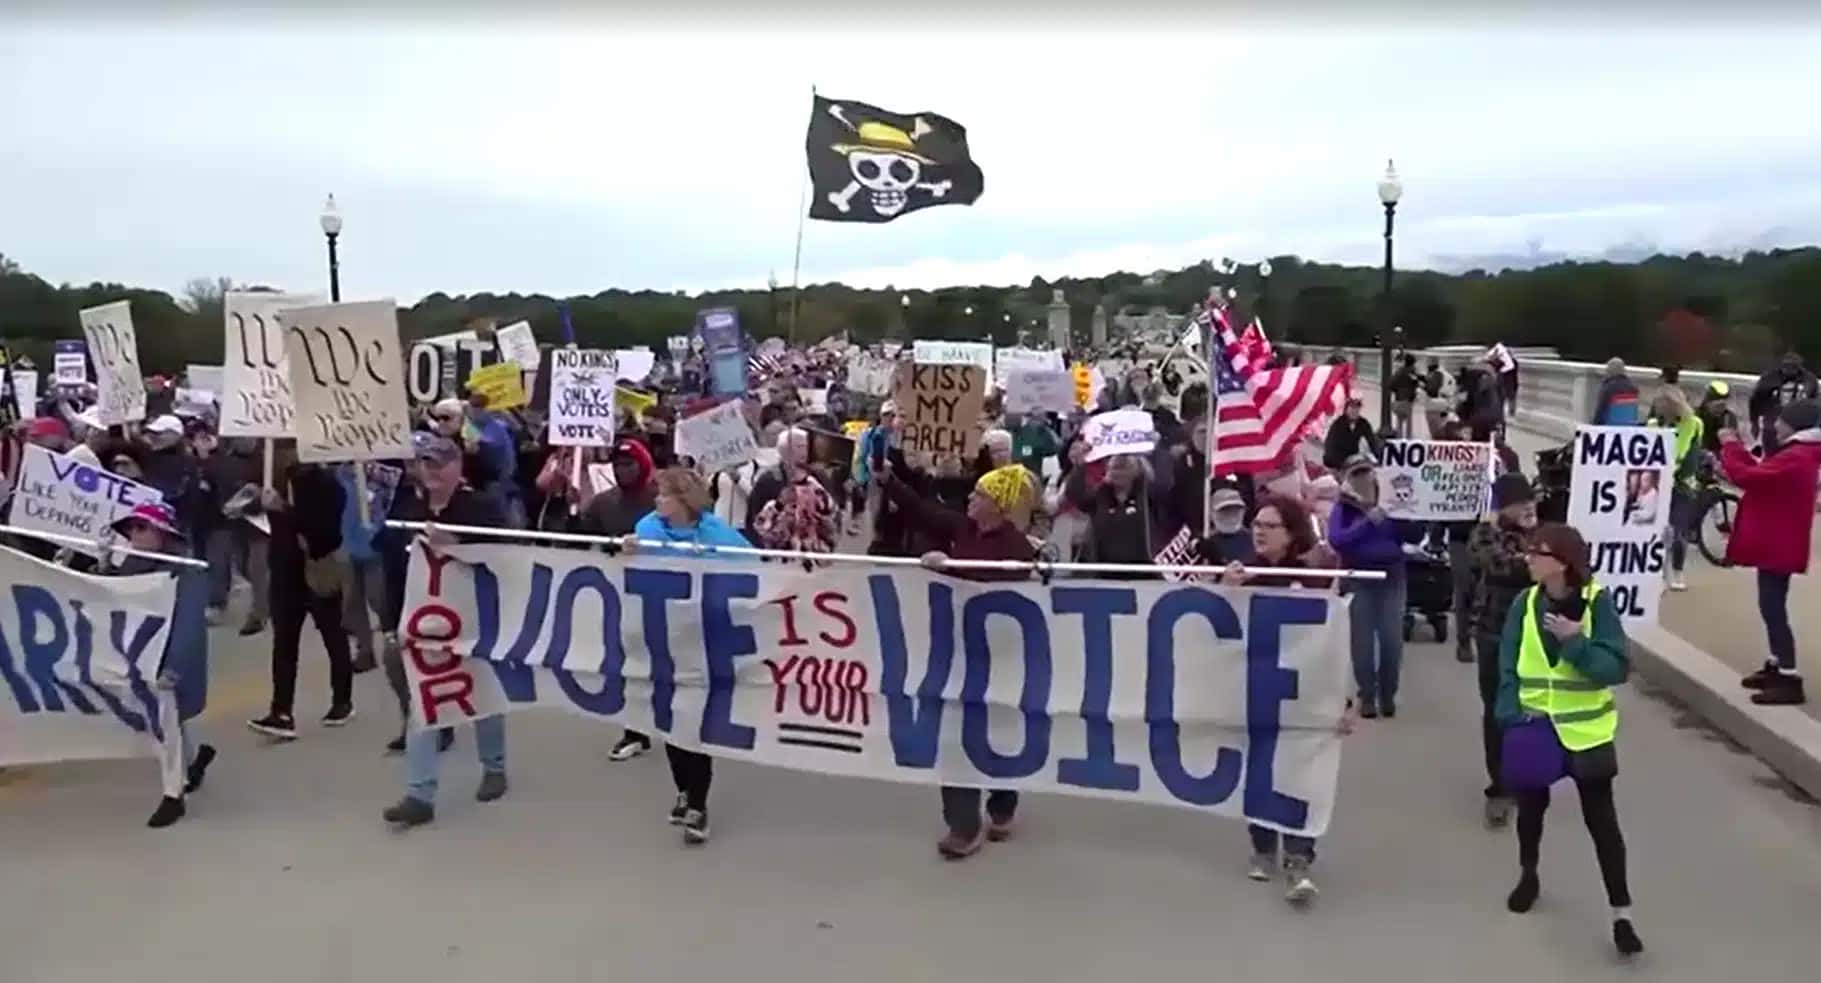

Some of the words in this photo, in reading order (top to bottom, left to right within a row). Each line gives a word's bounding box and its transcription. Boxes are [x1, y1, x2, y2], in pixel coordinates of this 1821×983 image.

[231, 311, 282, 368] W
[291, 325, 387, 387] We
[557, 351, 577, 368] NO
[911, 364, 972, 392] KISS
[233, 391, 293, 431] Peop
[333, 388, 371, 420] the
[558, 402, 609, 417] VOTERS
[563, 387, 602, 404] ONLY
[916, 394, 959, 423] MY
[312, 412, 403, 452] People
[559, 423, 595, 438] VOTE
[900, 422, 966, 454] ARCH
[1386, 442, 1425, 467] NO
[1581, 431, 1667, 466] MAGA
[21, 471, 56, 500] LIKE
[47, 452, 138, 507] VOTE
[1421, 464, 1442, 482] OR
[1590, 480, 1616, 513] IS
[1588, 534, 1664, 574] UTIN'S
[404, 541, 477, 725] YOUR
[766, 591, 858, 648] IS
[472, 562, 760, 751] VOTE
[764, 655, 870, 727] YOUR
[868, 574, 1328, 830] VOICE
